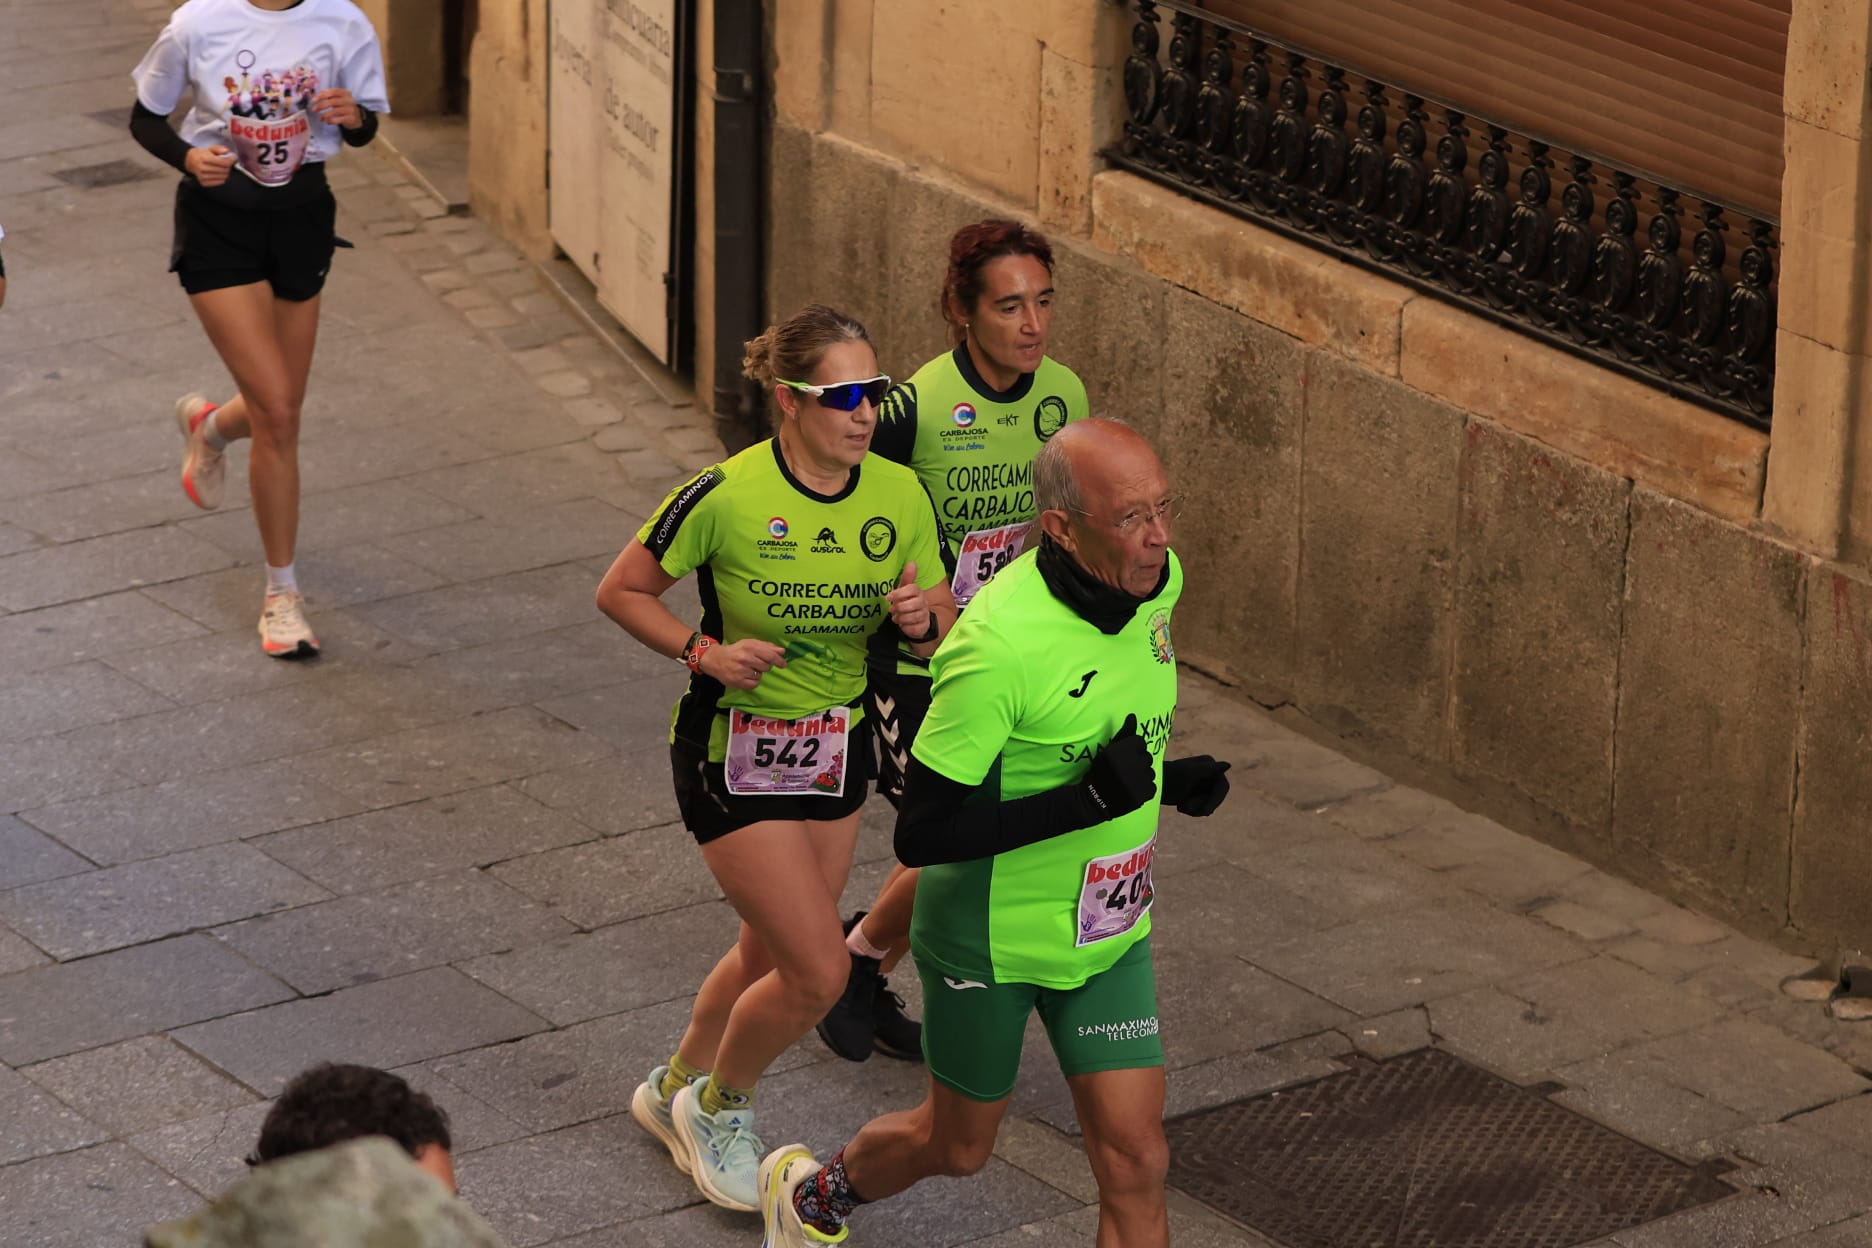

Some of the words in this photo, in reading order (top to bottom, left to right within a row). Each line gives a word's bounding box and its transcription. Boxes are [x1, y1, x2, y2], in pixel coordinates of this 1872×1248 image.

[257, 141, 288, 165] 25
[940, 428, 988, 437] CARBAJOSA
[947, 460, 1031, 492] CORRECAMI
[656, 472, 713, 544] CORRECAMINOS
[748, 579, 894, 598] CORRECAMINOS
[767, 603, 881, 619] CARBAJOSA
[784, 624, 865, 634] SALAMANCA
[754, 737, 820, 768] 542
[1078, 1017, 1155, 1036] SANMAXIMO
